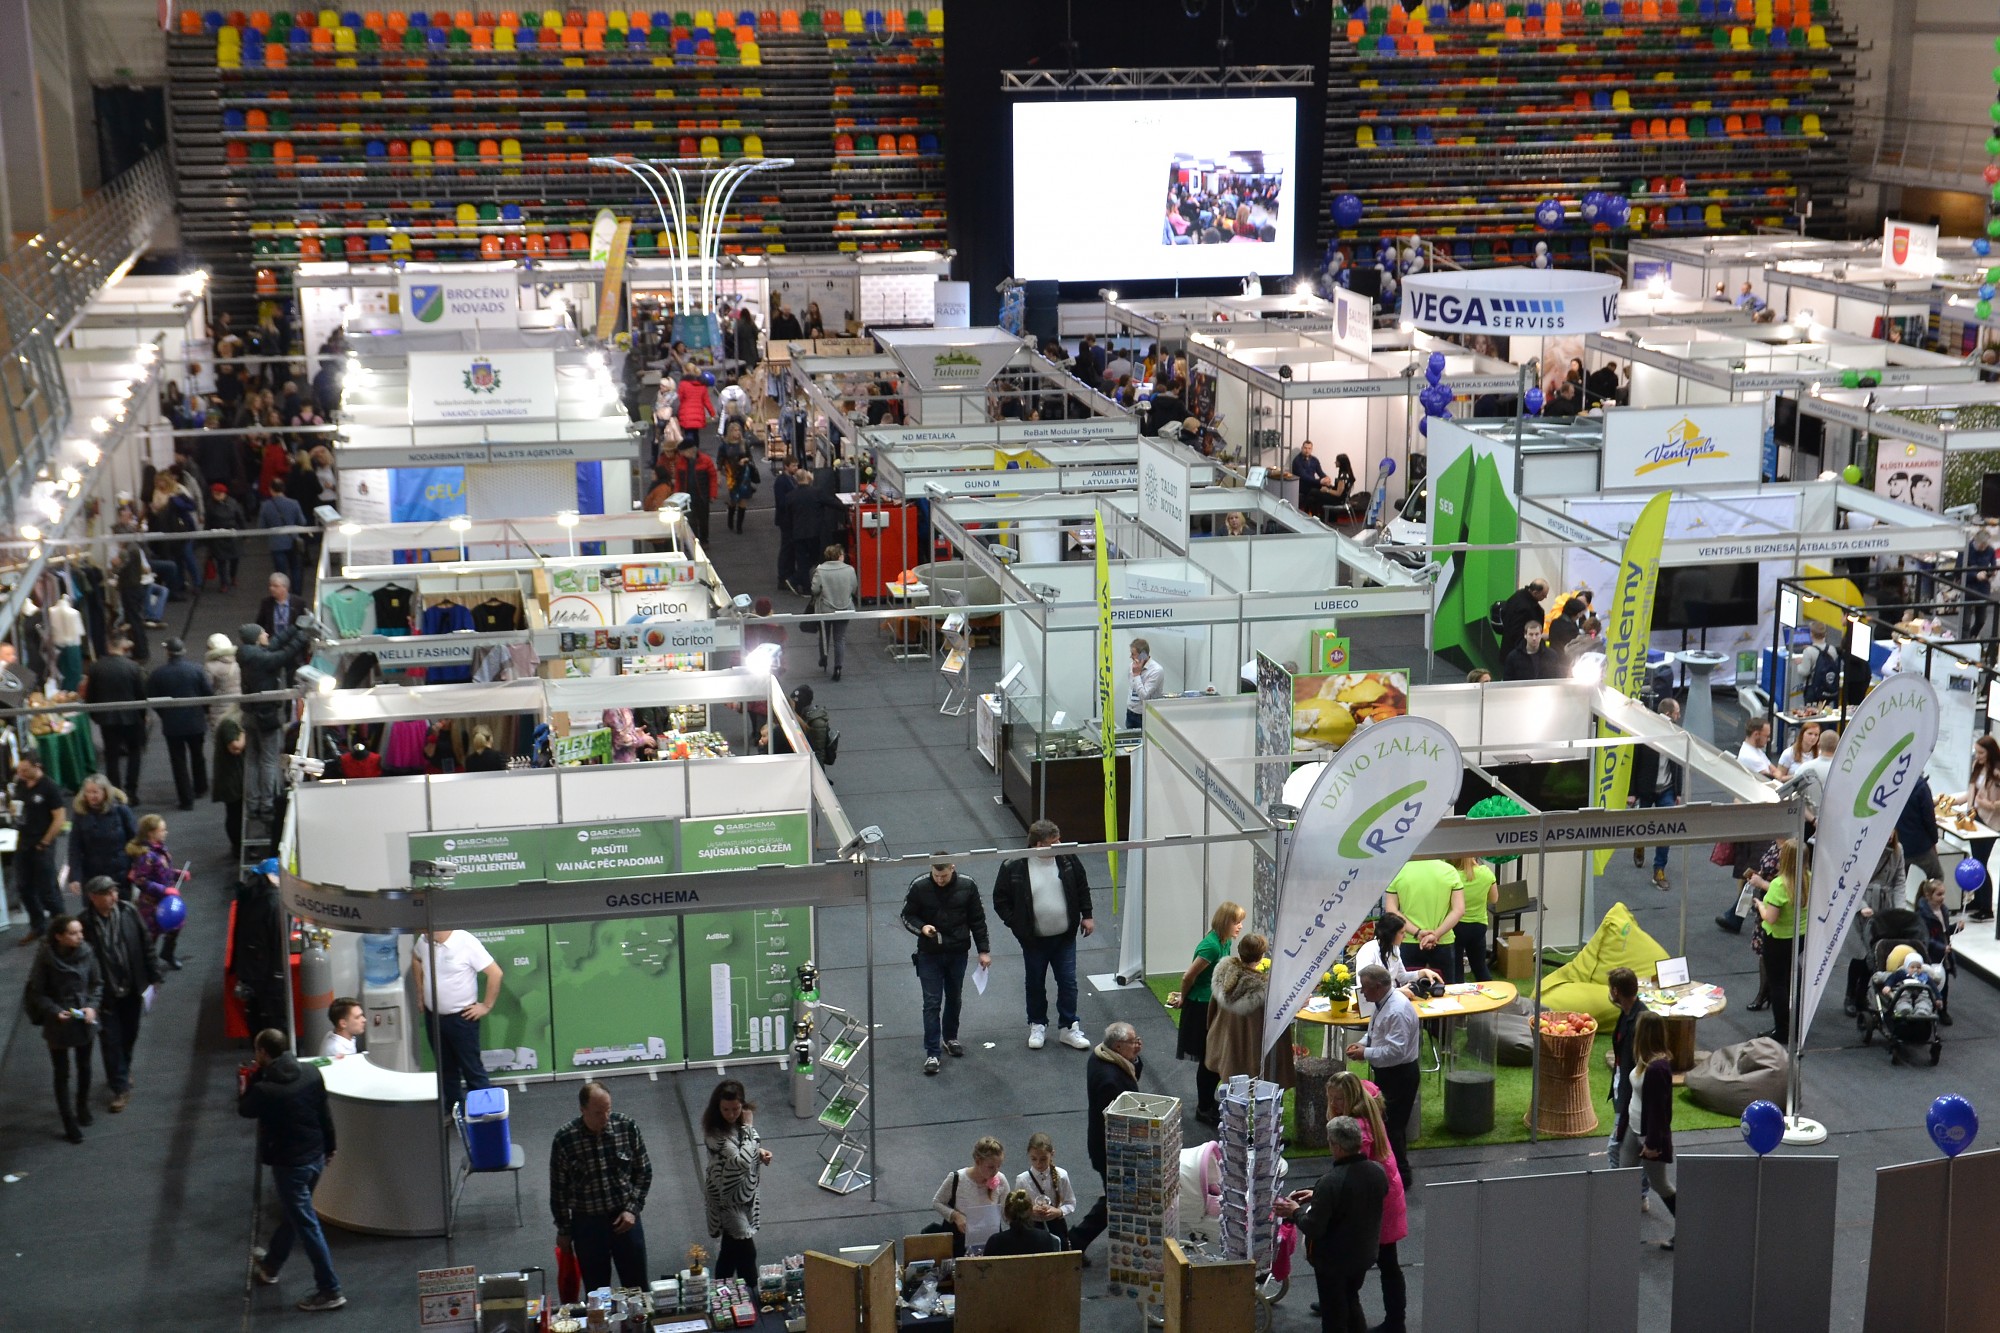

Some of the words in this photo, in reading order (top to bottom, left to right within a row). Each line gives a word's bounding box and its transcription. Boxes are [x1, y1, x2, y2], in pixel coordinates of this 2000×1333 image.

[447, 286, 510, 299] BROCĒNU
[451, 302, 505, 314] NOVADS
[1410, 290, 1488, 326] VEGA
[1492, 316, 1565, 328] SERVISS
[933, 366, 980, 377] Tukums
[1342, 385, 1381, 393] MAIZNIEKS
[1483, 379, 1520, 388] KOMBINĀT
[915, 432, 956, 440] METALIKA
[1023, 428, 1049, 437] ReBalt
[1050, 427, 1080, 435] Modular
[1083, 426, 1114, 436] Systems
[492, 449, 524, 459] VALSTS
[1645, 436, 1716, 467] Ventspils
[1091, 469, 1127, 477] ADMIRAL
[964, 480, 991, 488] GUNO
[1082, 478, 1120, 486] LATVIJAS
[1160, 477, 1178, 499] TALSU
[1160, 499, 1183, 523] NOVADS
[1439, 498, 1454, 515] SEB
[1698, 544, 1752, 556] VENTSPILS
[1754, 543, 1796, 554] BIZNESA
[1799, 540, 1849, 552] ATBALSTA
[1851, 538, 1890, 550] CENTRS
[636, 601, 688, 617] tarlton
[1314, 599, 1359, 611] LUBECO
[1110, 608, 1173, 620] PRIEDNIEKI
[671, 634, 714, 647] tarlton
[379, 649, 414, 660] NELLI
[417, 646, 470, 658] FASHION
[1841, 715, 1877, 775] DZĪVO
[1878, 690, 1927, 718] ZAĻĀK
[1321, 754, 1372, 811] DZĪVO
[1374, 736, 1446, 762] ZAĻĀK
[1873, 751, 1913, 809] Ras
[589, 827, 641, 836] GASCHEMA
[726, 821, 776, 830] GASCHEMA
[1366, 800, 1423, 854] Ras
[1495, 830, 1538, 844] VIDES
[1545, 820, 1688, 841] APSAIMNIEKOŠANA
[456, 837, 509, 845] GASCHEMA
[591, 844, 628, 855] PASŪTI!
[698, 846, 740, 859] SAJŪSMĀ
[741, 846, 756, 855] NO
[757, 843, 792, 853] GĀZĒM
[469, 854, 488, 863] PAR
[488, 852, 518, 862] VIENU
[556, 861, 573, 871] VAI
[574, 860, 596, 870] NĀC
[597, 858, 616, 868] PĒC
[617, 855, 664, 867] PADOMA!
[476, 861, 526, 872] KLIENTIEM
[1818, 825, 1870, 925] Liepājas
[605, 889, 700, 907] GASCHEMA
[294, 894, 362, 919] GASCHEMA
[1283, 867, 1360, 959] Liepājas
[705, 932, 730, 941] AdBlue
[1813, 880, 1862, 987] www.liepajasras.lv
[1273, 921, 1348, 1021] www.liepajasras.lv
